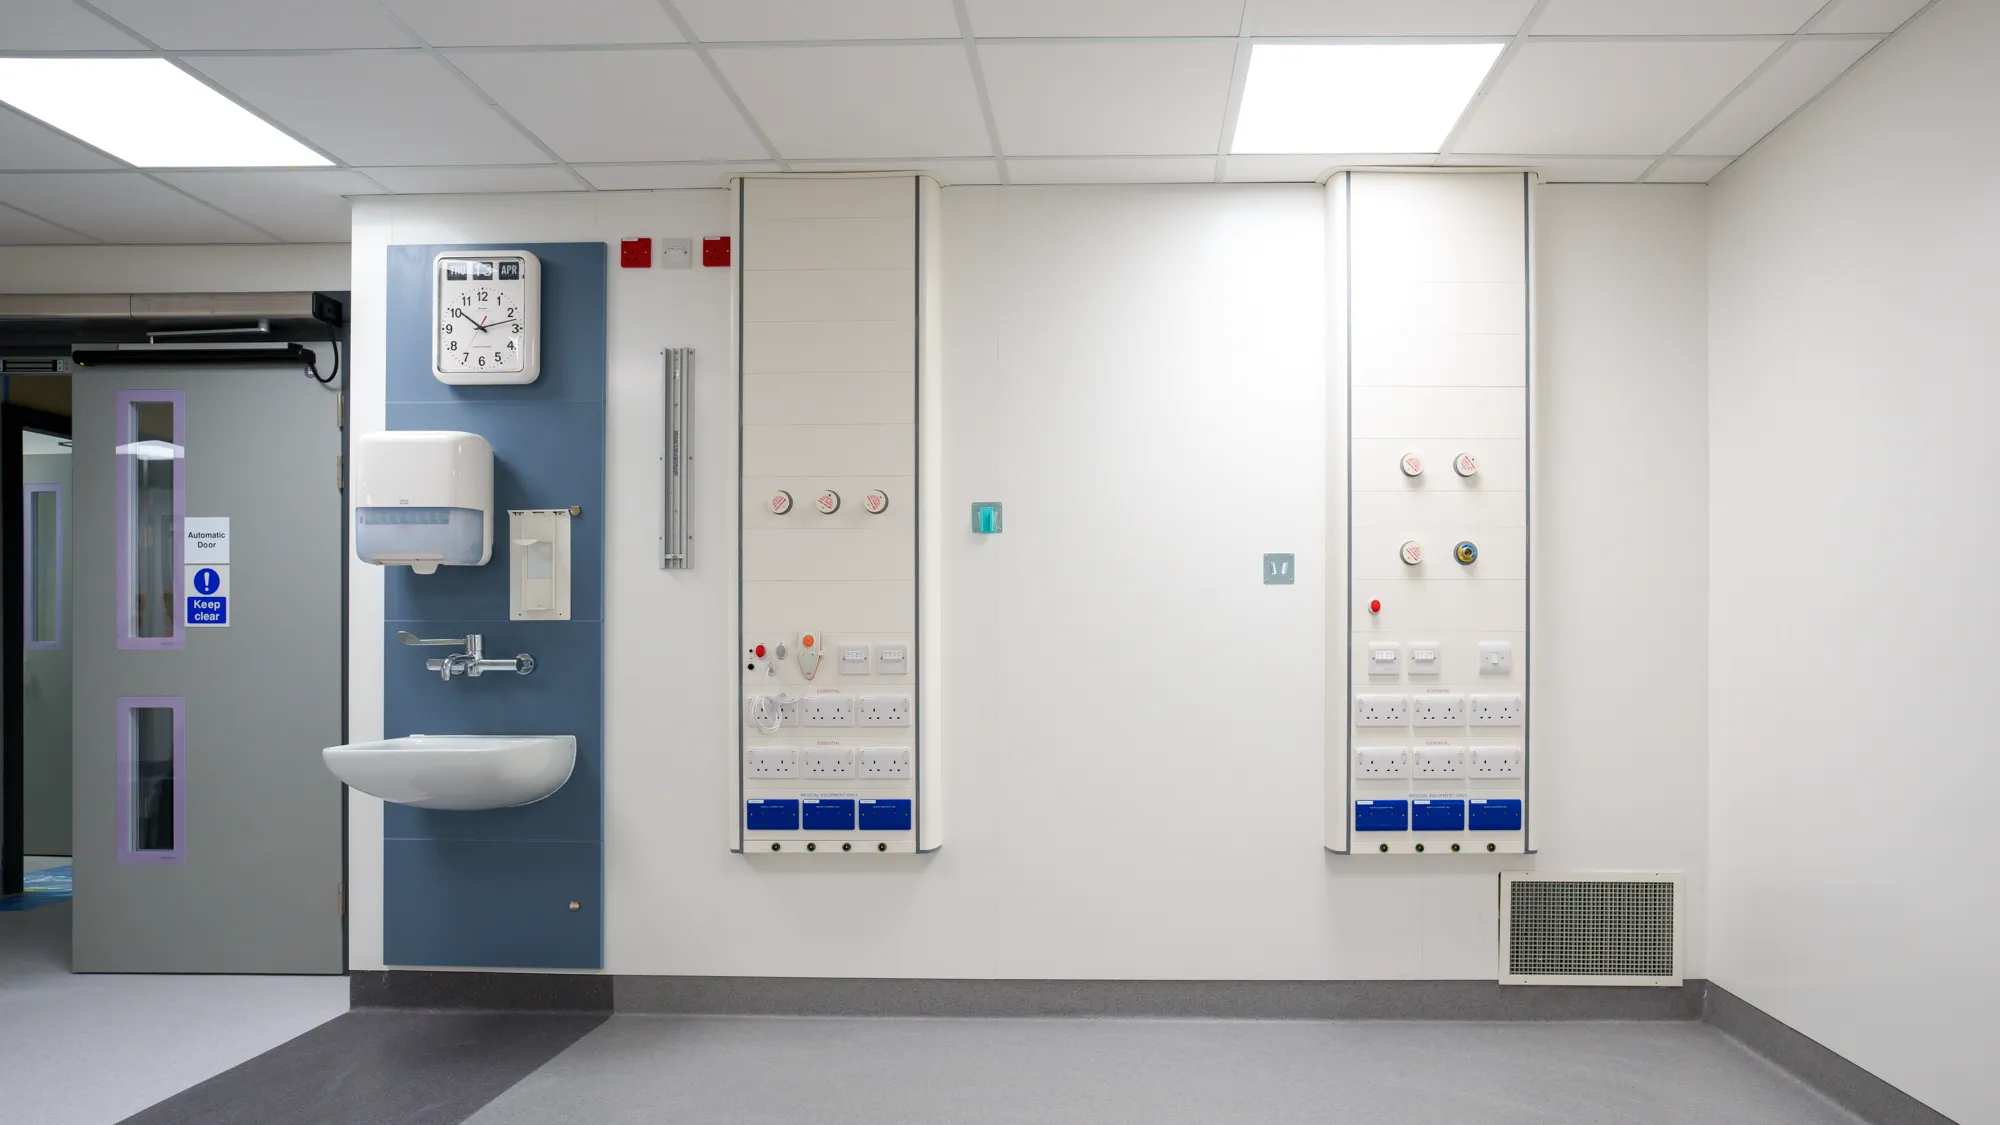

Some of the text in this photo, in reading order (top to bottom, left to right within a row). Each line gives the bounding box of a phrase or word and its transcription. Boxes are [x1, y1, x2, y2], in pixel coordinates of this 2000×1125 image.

[501, 265, 518, 275] APR
[462, 296, 471, 306] 11
[477, 291, 488, 302] 12
[497, 296, 501, 306] 1
[450, 308, 462, 318] 10
[507, 308, 514, 318] 2
[445, 324, 453, 334] 9
[511, 324, 519, 334] 3
[450, 341, 457, 351] 8
[507, 341, 514, 350] 4
[463, 352, 469, 362] 7
[478, 356, 485, 366] 6
[494, 352, 502, 362] 5
[187, 531, 226, 539] Automatic
[193, 599, 221, 611] Keep
[194, 611, 220, 621] clear
